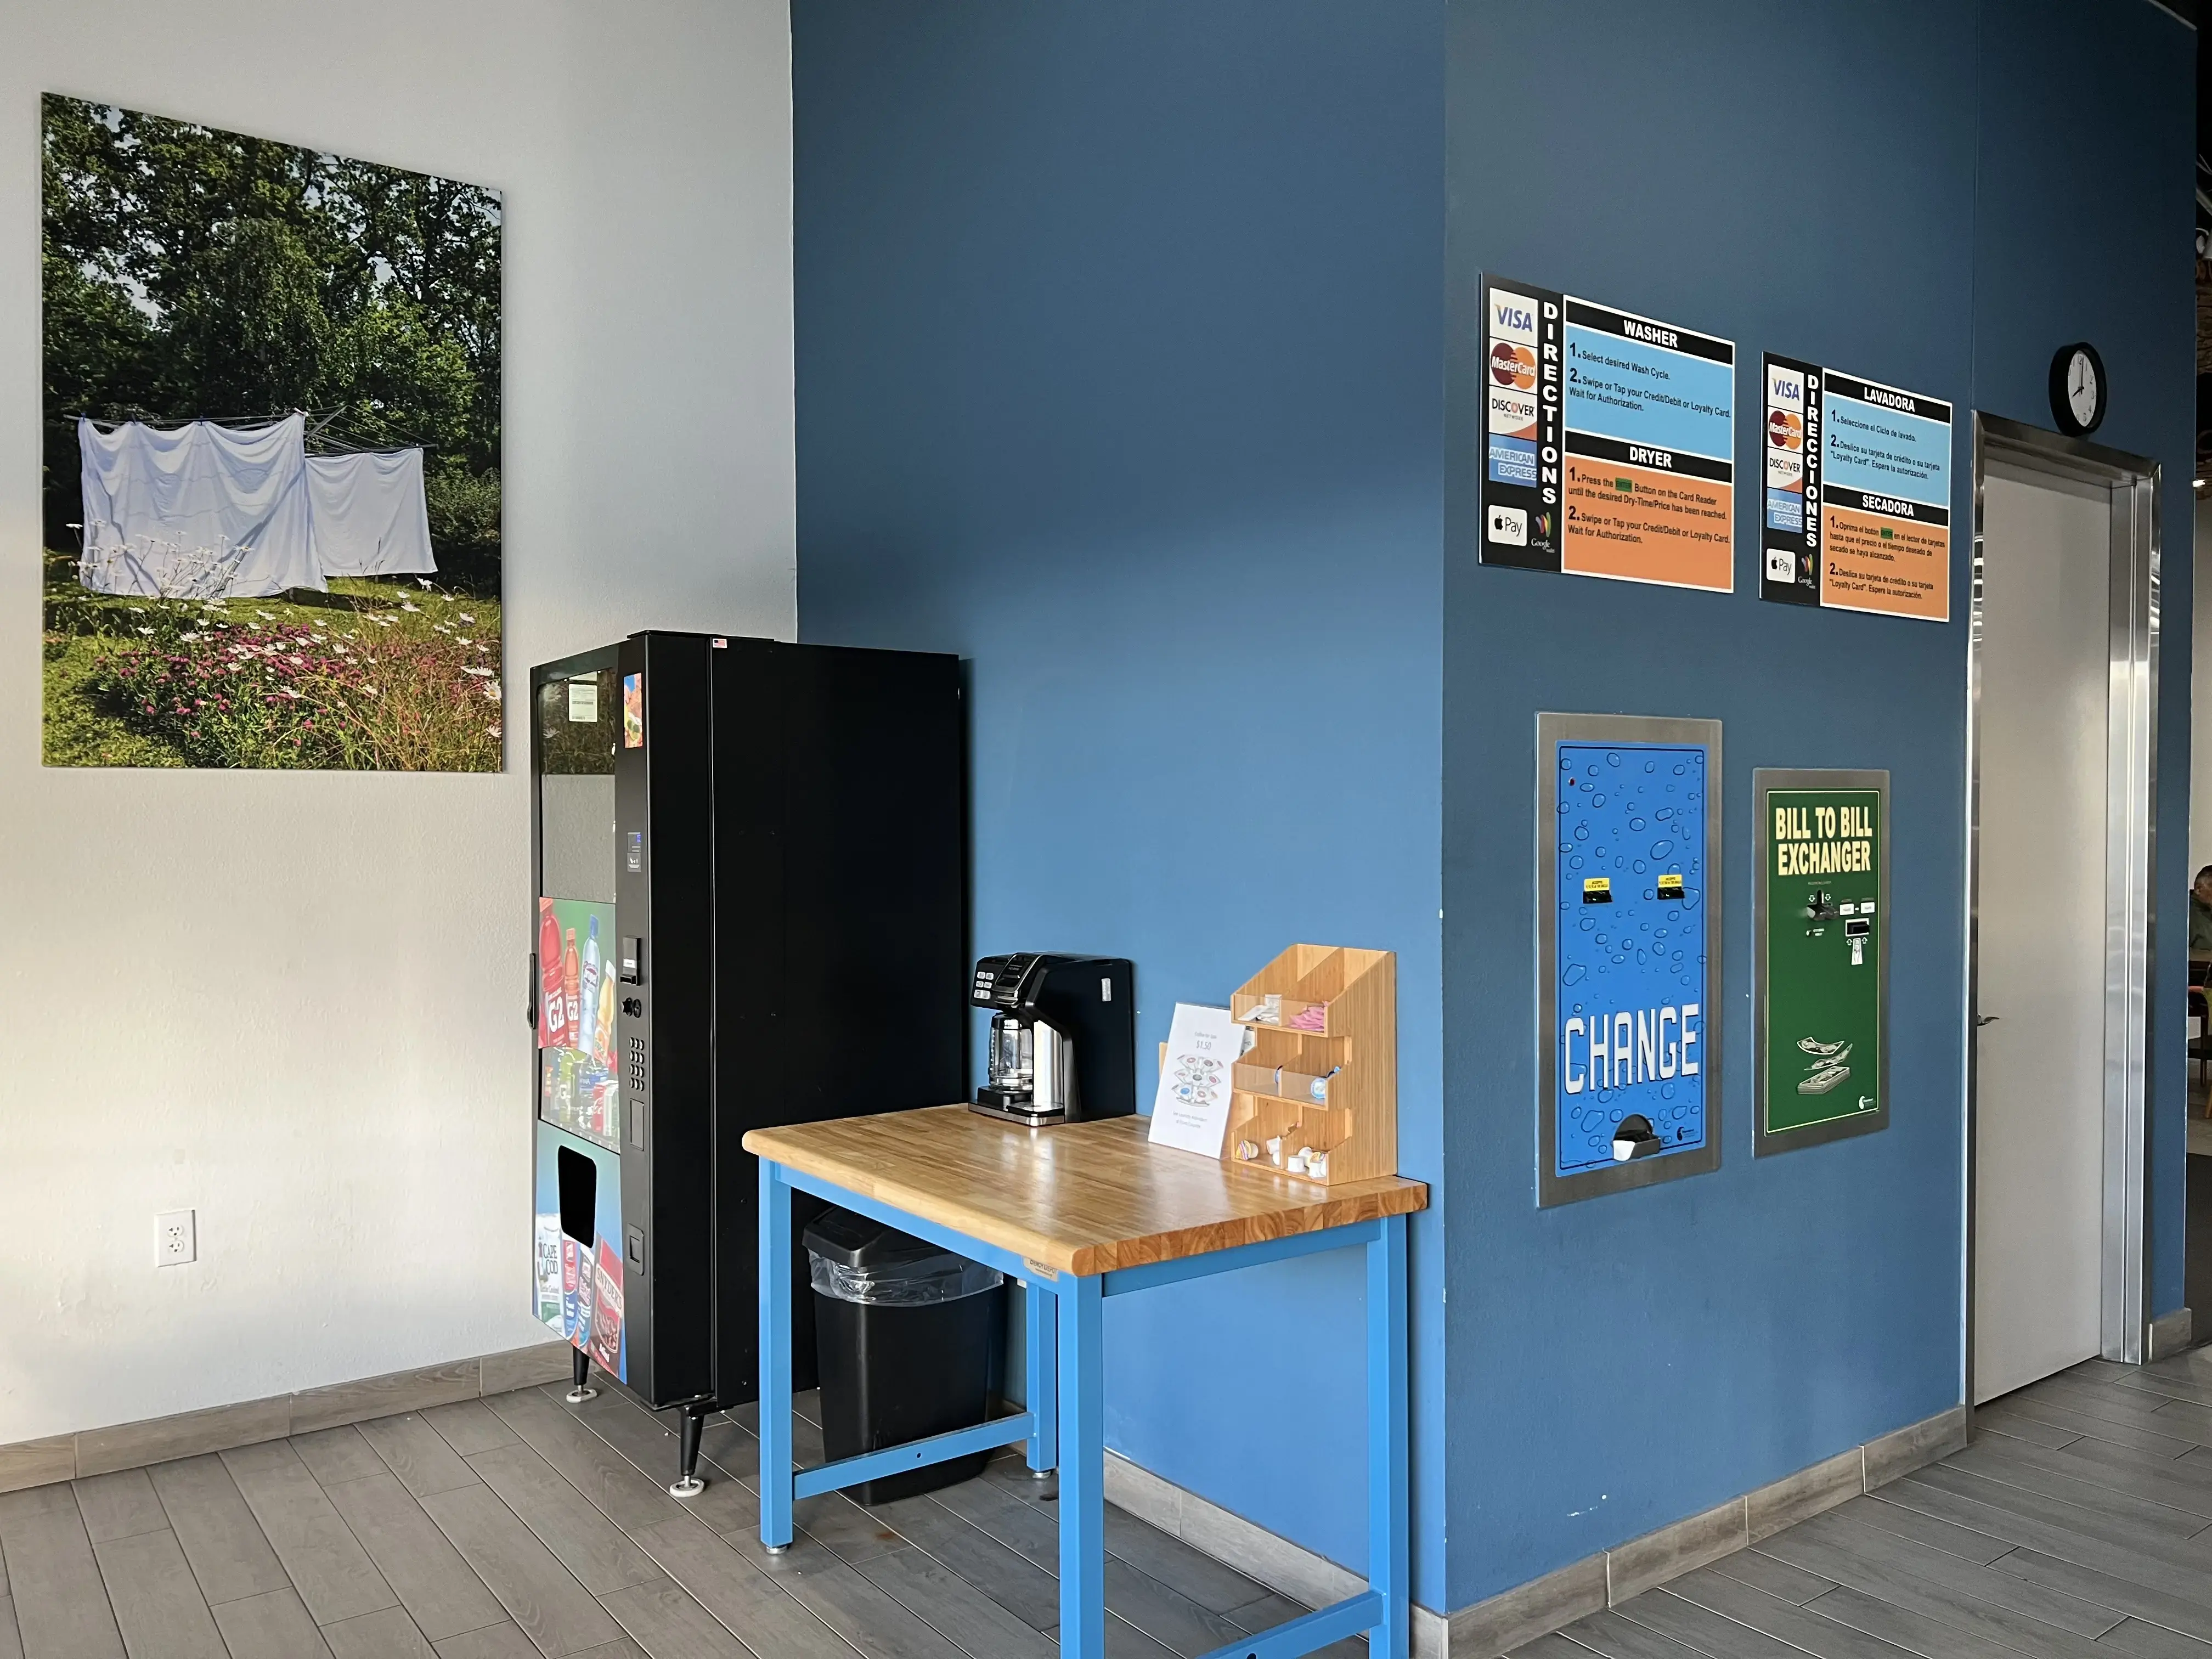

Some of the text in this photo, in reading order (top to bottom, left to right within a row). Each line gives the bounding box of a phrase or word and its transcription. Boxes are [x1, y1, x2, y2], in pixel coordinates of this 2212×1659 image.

[1494, 303, 1532, 332] VISA
[1624, 320, 1678, 348] WASHER
[1491, 356, 1536, 376] MasterCard
[1570, 342, 1670, 380] 1. Select desired Wash Cycle.
[1570, 368, 1581, 383] 2.
[1583, 376, 1603, 389] Swipe
[1613, 383, 1626, 395] Tap
[1627, 388, 1643, 397] your
[1644, 390, 1681, 407] Credit/Debit
[1691, 402, 1713, 415] Loyalty
[1714, 407, 1731, 417] Card.
[1570, 387, 1644, 411] Wait for Authorization.
[1771, 378, 1799, 401] VISA
[1864, 387, 1915, 413] LAVADORA
[1492, 398, 1534, 417] DISCOVER
[1543, 302, 1558, 504] DIRECTIONS
[1769, 422, 1801, 438] MasterCard
[1831, 409, 1839, 422] 1.
[1876, 426, 1889, 435] Ciclo
[1898, 431, 1916, 442] lavado.
[1489, 447, 1534, 465] AMERICAN
[1629, 446, 1672, 468] DRYER
[1807, 374, 1819, 547] DIRECCIONES
[1830, 450, 1853, 464] "Loyalty
[1891, 464, 1895, 472] la
[1831, 434, 1839, 448] 2.
[1840, 441, 1859, 452] Deslice
[1869, 448, 1885, 459] tarjeta
[1925, 461, 1940, 471] tarjeta
[1499, 464, 1537, 479] EXPRESS
[1769, 458, 1801, 473] DISCOVER
[1570, 466, 1581, 482] 1.
[1582, 474, 1601, 486] Press
[1603, 478, 1613, 487] the
[1634, 483, 1656, 494] Button
[1668, 489, 1678, 499] the
[1679, 492, 1694, 501] Card
[1696, 494, 1717, 505] Reader
[1568, 487, 1583, 495] until
[1585, 488, 1596, 498] the
[1598, 491, 1622, 502] desired
[1672, 503, 1683, 512] has
[1685, 505, 1700, 515] been
[1701, 510, 1726, 520] reached.
[1767, 499, 1800, 514] AMERICAN
[1863, 494, 1914, 517] SECADORA
[1505, 517, 1522, 537] Pay
[1568, 505, 1580, 521] 2.
[1581, 513, 1602, 525] Swipe
[1612, 518, 1624, 529] Tap
[1626, 522, 1641, 530] your
[1643, 522, 1680, 536] Credit/Debit
[1690, 529, 1712, 542] Loyalty
[1714, 533, 1730, 543] Card.
[1568, 524, 1643, 543] Wait for Authorization.
[1830, 516, 1838, 528] 1.
[1839, 522, 1858, 531] Oprima
[1906, 534, 1920, 544] lector
[1928, 538, 1945, 548] tarjetas
[1531, 538, 1550, 550] Google
[1830, 531, 1844, 541] hasta
[1888, 543, 1905, 552] tiempo
[1905, 546, 1926, 555] deseado
[1830, 545, 1848, 554] secado
[1857, 548, 1868, 558] haya
[1779, 558, 1792, 575] Pay
[1830, 562, 1838, 575] 2.
[1866, 573, 1881, 583] tarjeta
[1918, 582, 1934, 590] tarjeta
[1829, 579, 1850, 591] "Loyalty
[1776, 806, 1872, 839] BILL TO BILL
[1778, 840, 1871, 876] EXCHANGER
[549, 996, 565, 1032] G2
[567, 1000, 579, 1022] G2
[1565, 1003, 1699, 1094] CHANGE
[543, 1243, 557, 1259] CAPE
[546, 1259, 558, 1276] COD
